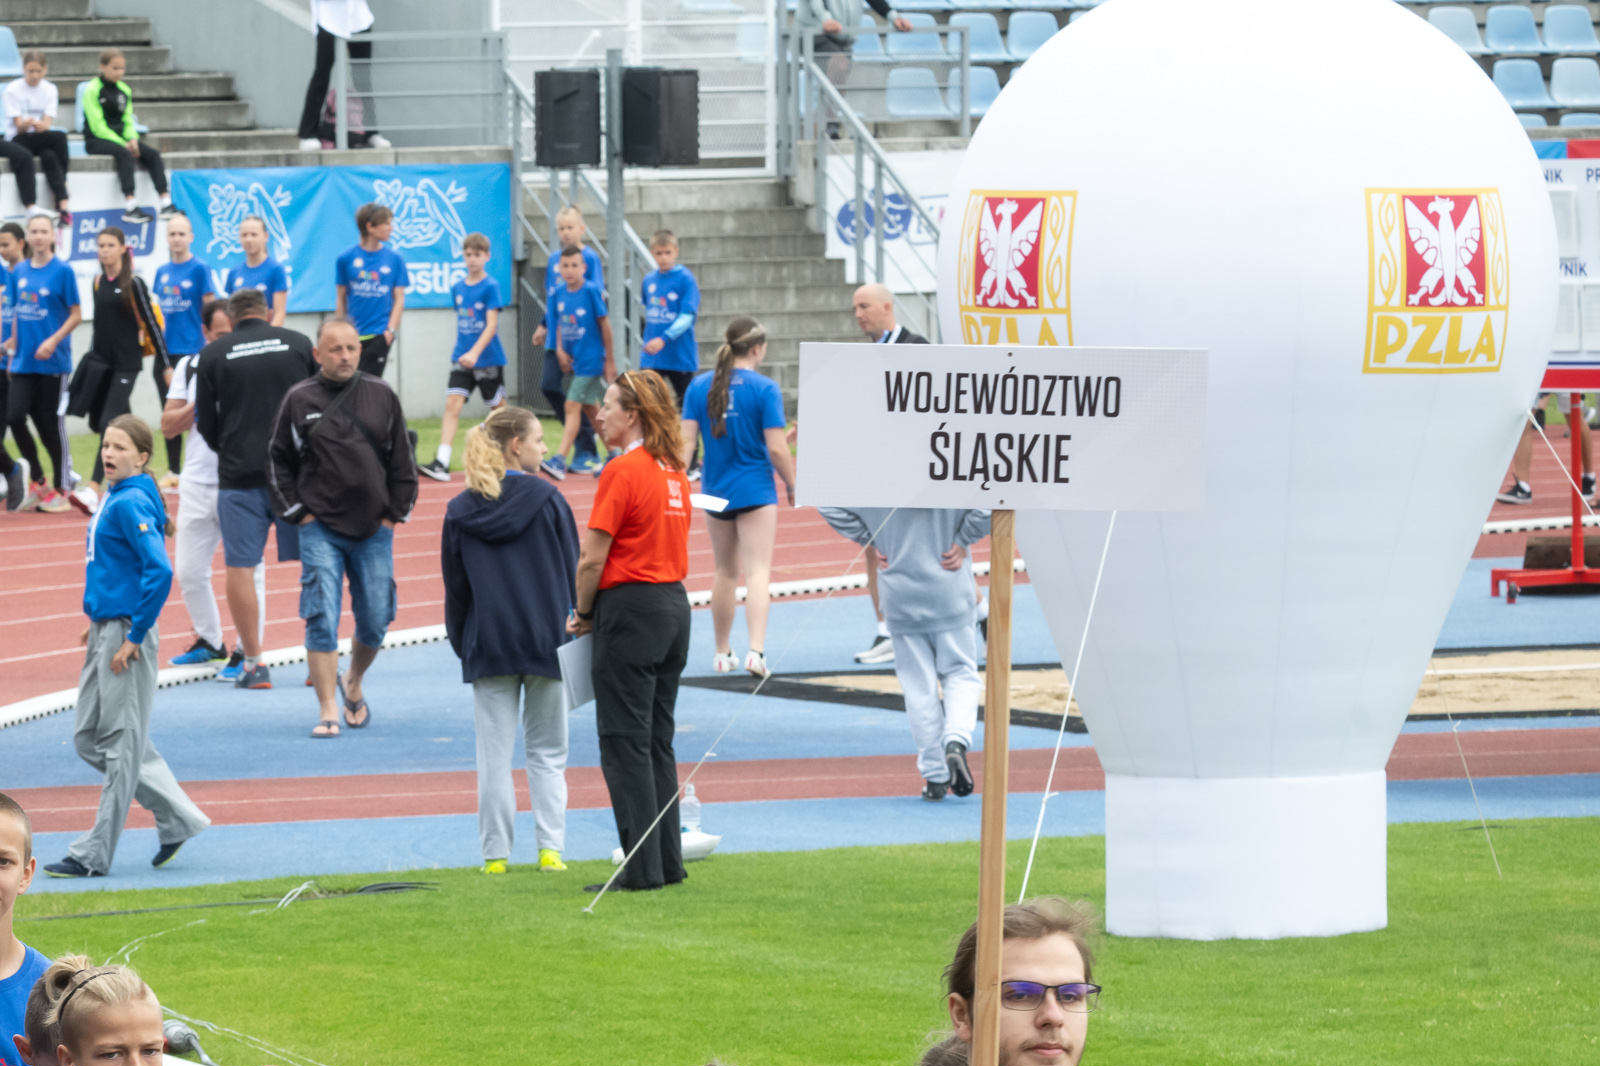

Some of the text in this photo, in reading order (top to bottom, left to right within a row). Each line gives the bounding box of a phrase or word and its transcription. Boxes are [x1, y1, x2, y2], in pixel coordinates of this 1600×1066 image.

[1373, 314, 1497, 364] PZLA
[885, 366, 1122, 417] WOJEWÓDZTWO
[929, 422, 1072, 490] ŚLĄSKIE
